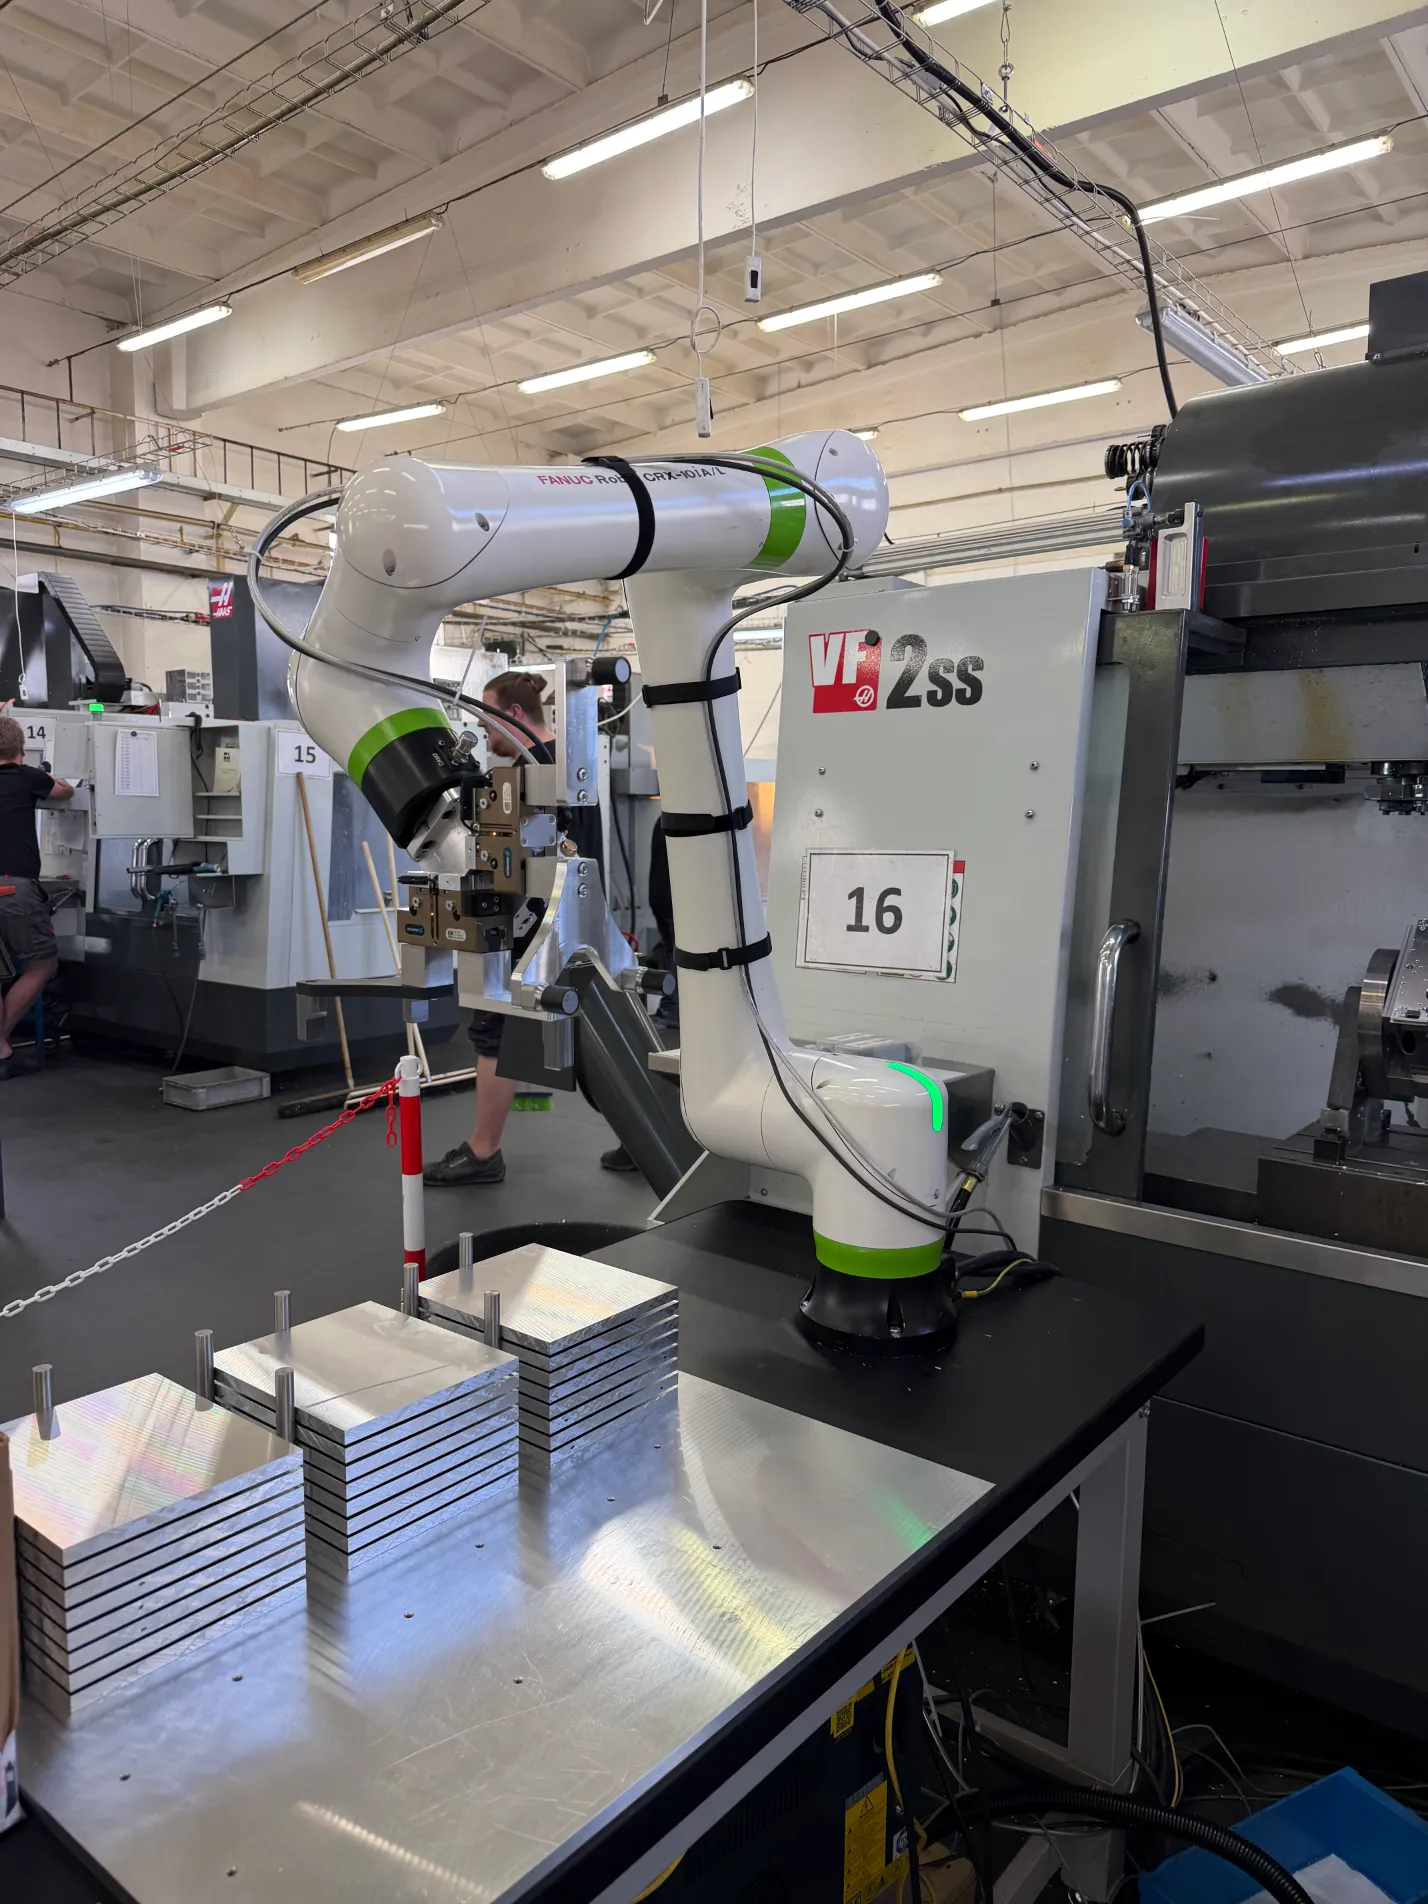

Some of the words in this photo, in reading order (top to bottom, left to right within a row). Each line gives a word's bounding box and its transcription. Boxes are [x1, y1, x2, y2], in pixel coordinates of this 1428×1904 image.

[537, 474, 594, 486] FANUC
[213, 606, 233, 618] HAAS
[27, 725, 46, 740] 14
[294, 745, 316, 764] 15
[846, 886, 903, 935] 16
